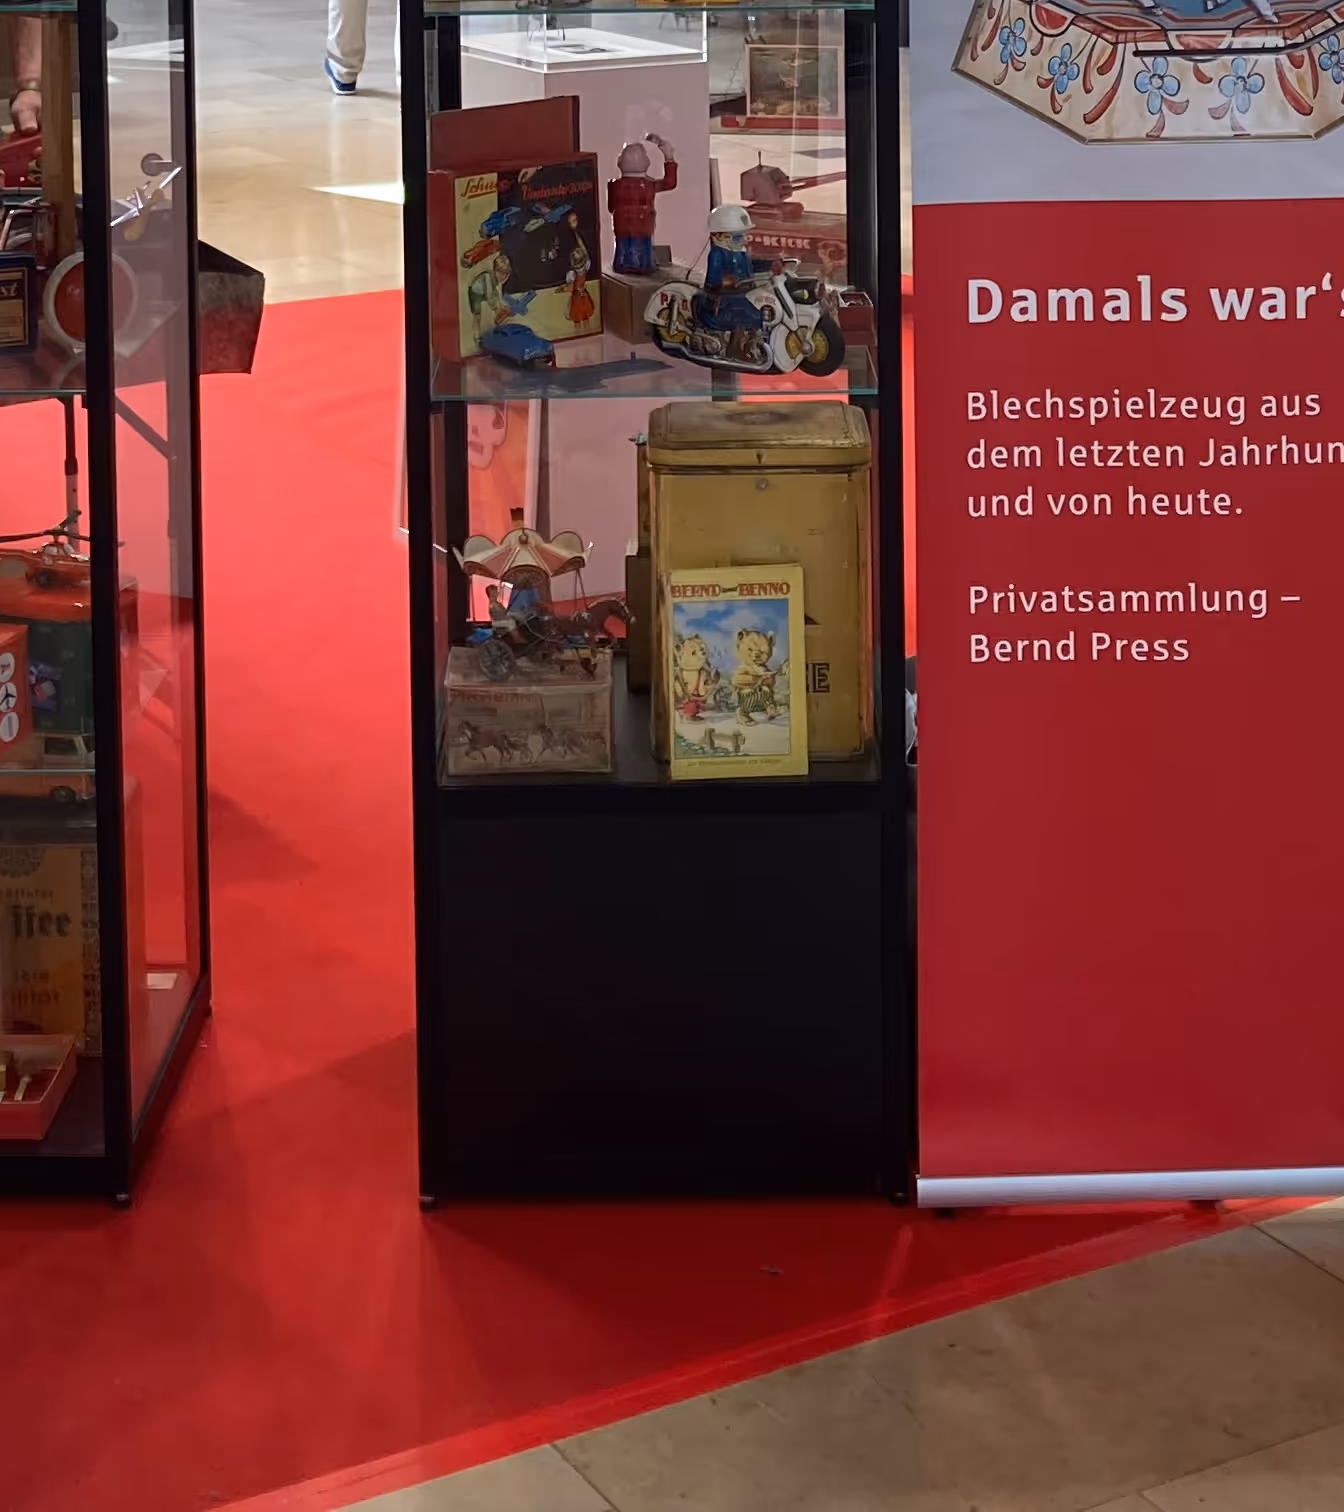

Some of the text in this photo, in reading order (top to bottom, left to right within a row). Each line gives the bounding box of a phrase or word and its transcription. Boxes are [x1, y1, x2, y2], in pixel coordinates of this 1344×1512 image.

[968, 274, 1188, 323] Damals
[967, 388, 1321, 426] Blechspielzeug aus
[967, 438, 1041, 469] dem
[1055, 436, 1184, 467] letzten
[968, 485, 1243, 518] und von heute.
[671, 583, 722, 599] BERND
[737, 581, 791, 597] BENNO
[969, 582, 1267, 619] Privatsammlung
[970, 630, 1189, 663] Bernd Press
